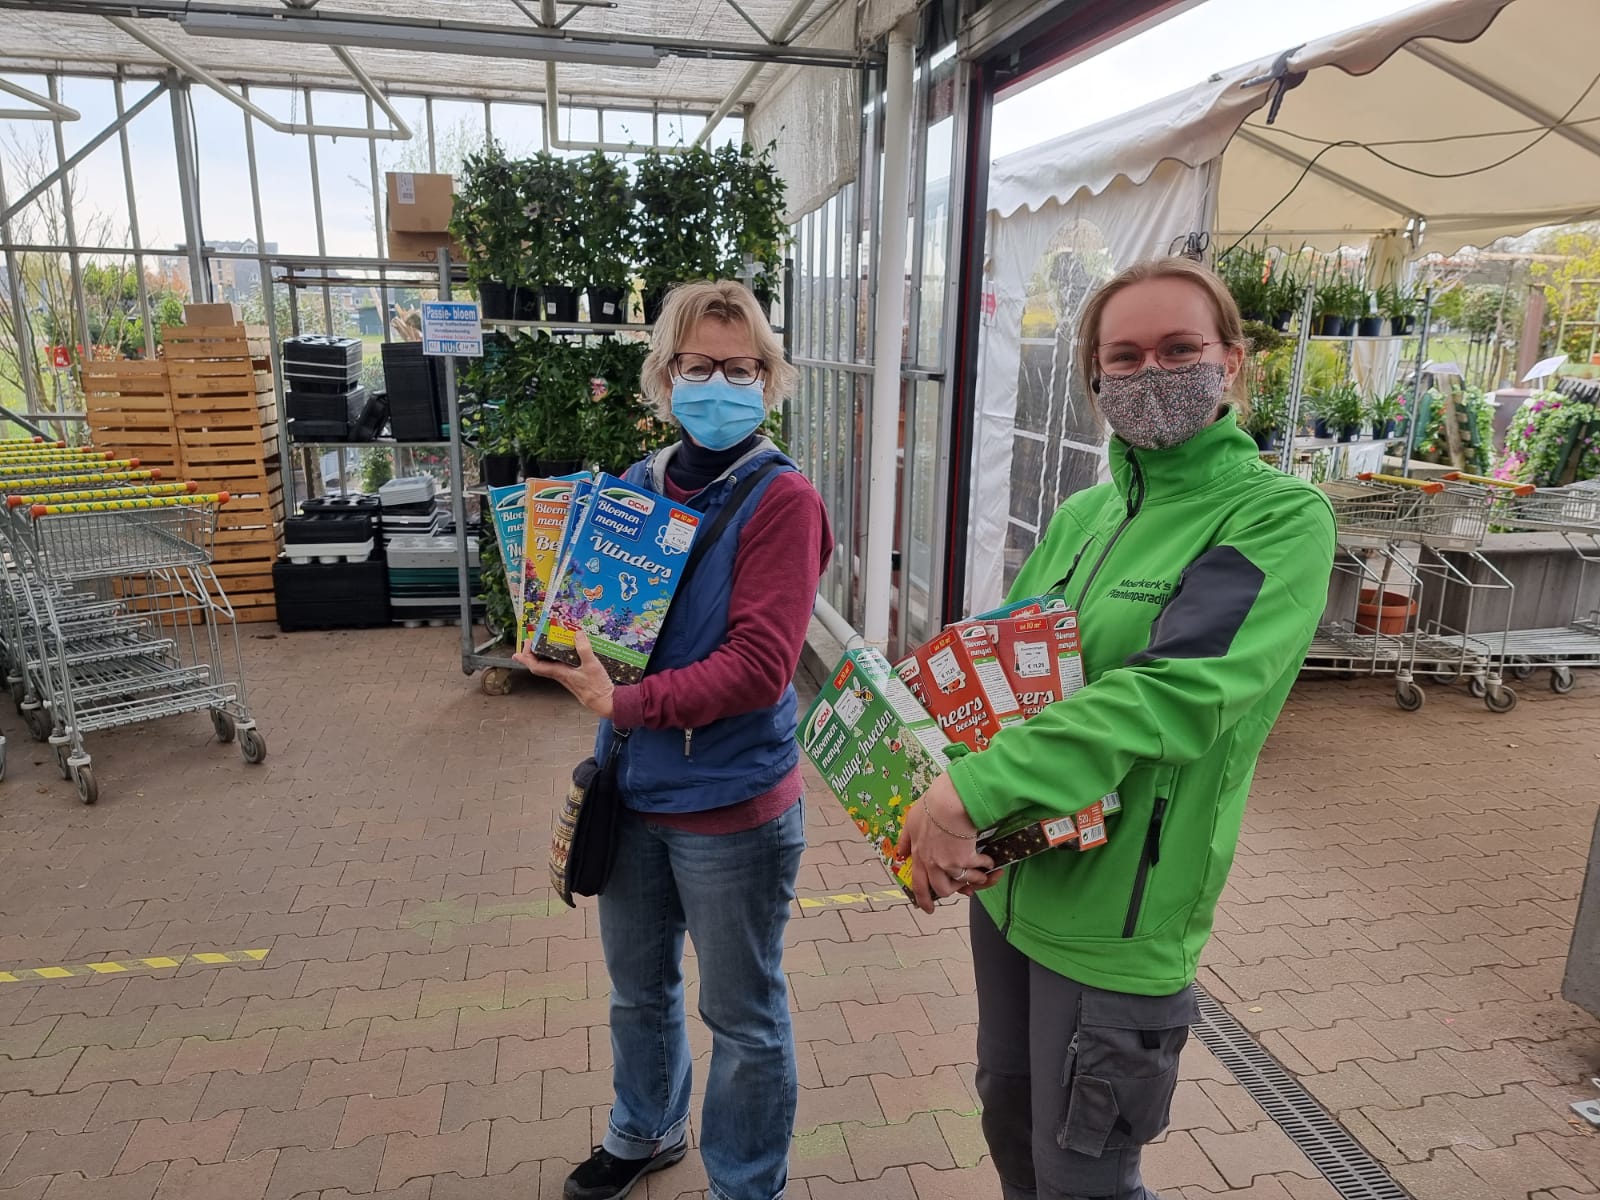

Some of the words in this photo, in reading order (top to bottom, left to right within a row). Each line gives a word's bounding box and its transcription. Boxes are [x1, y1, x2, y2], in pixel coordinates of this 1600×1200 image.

[453, 306, 476, 320] bloem
[501, 511, 524, 522] Bloe
[535, 504, 567, 514] Bloem
[598, 500, 643, 524] Bloemen-
[627, 499, 649, 513] DCM
[595, 515, 639, 537] mengsel
[590, 534, 673, 579] Vlinders
[1119, 579, 1172, 591] Moerkerk's
[1106, 588, 1169, 609] Plantenparadij
[1027, 621, 1034, 629] 10
[817, 708, 831, 728] DCM
[937, 697, 983, 729] heers
[955, 711, 987, 733] beestjes
[811, 721, 839, 760] Bloemen-
[822, 730, 846, 769] mengsel
[831, 753, 862, 794] Nuttige
[858, 710, 893, 756] Insecten
